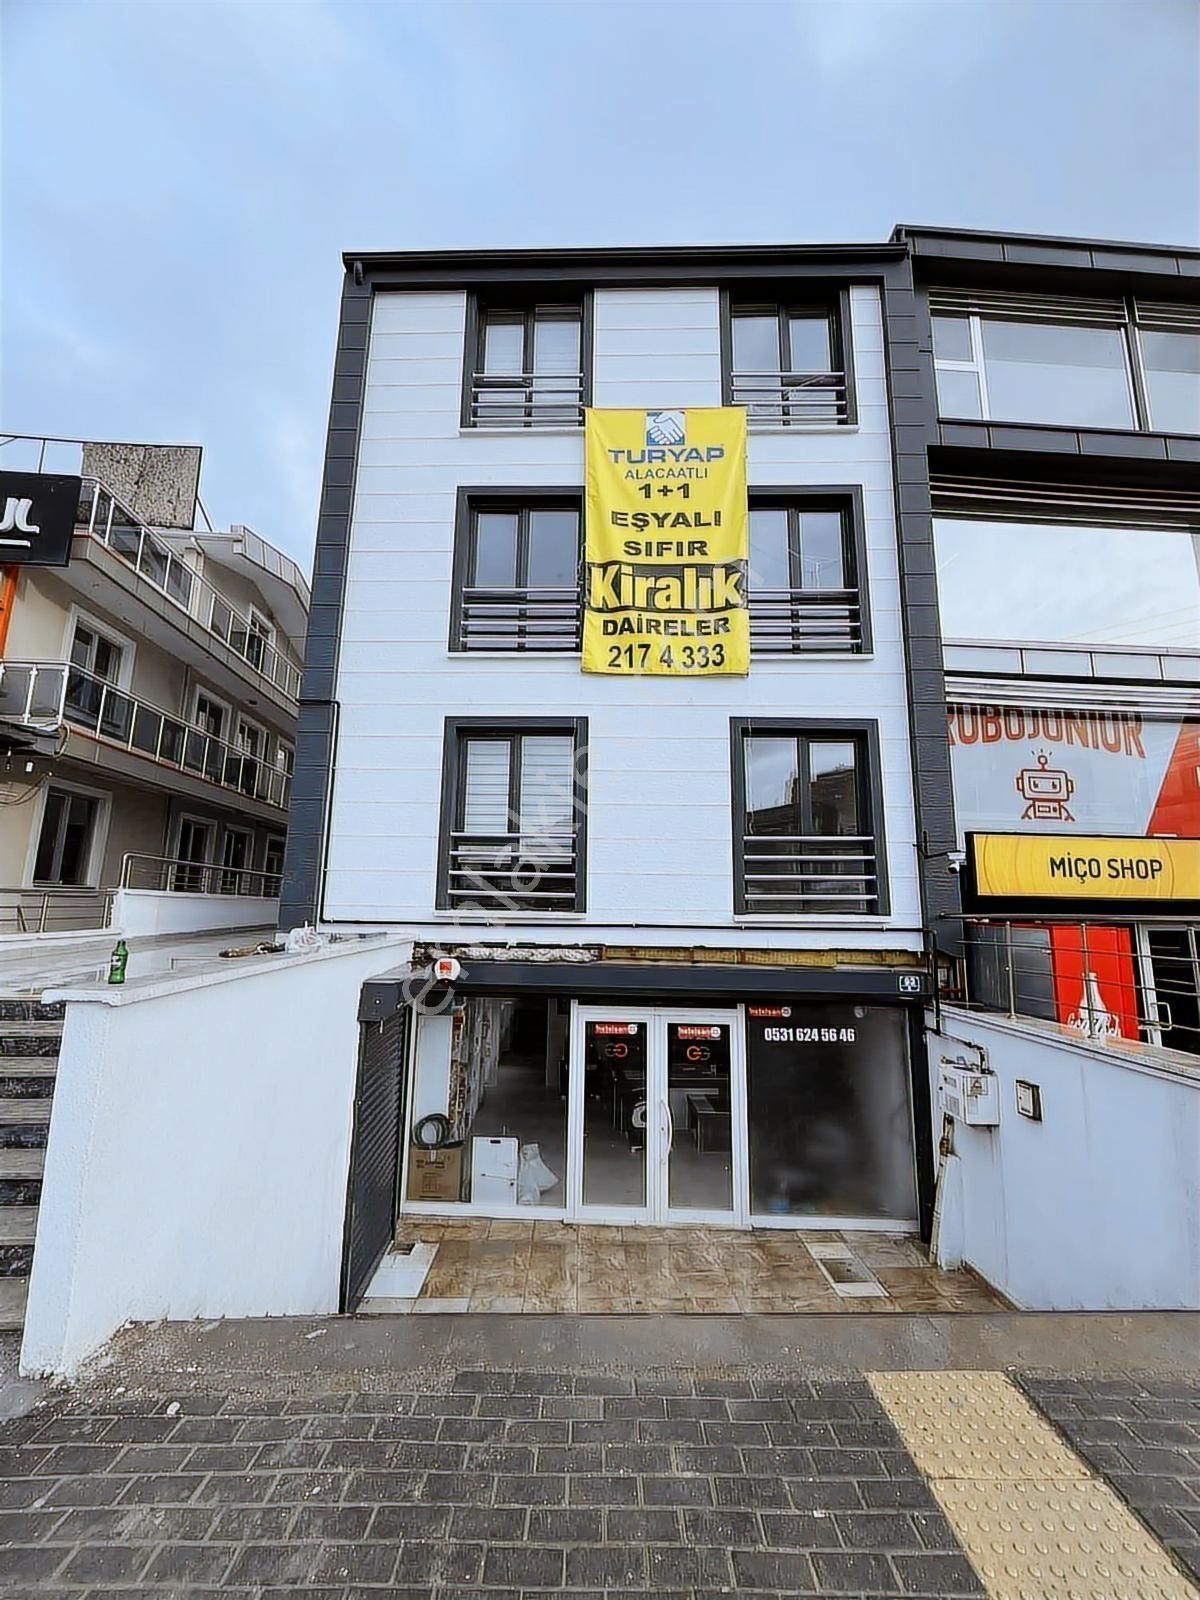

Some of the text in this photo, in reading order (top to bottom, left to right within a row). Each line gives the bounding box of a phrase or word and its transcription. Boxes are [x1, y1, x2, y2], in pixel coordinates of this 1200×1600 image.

[608, 447, 724, 464] TURYAP
[624, 467, 708, 480] ALACAATLI
[638, 483, 690, 499] 1+1
[611, 511, 721, 532] EŞYALI
[623, 541, 708, 557] SIFIR
[590, 564, 742, 610] Kiralık
[602, 613, 730, 636] DAİRELER
[608, 643, 725, 668] 217 4 333
[1049, 851, 1163, 885] MİÇO SHOP
[764, 1027, 855, 1042] 0531 624 56 46
